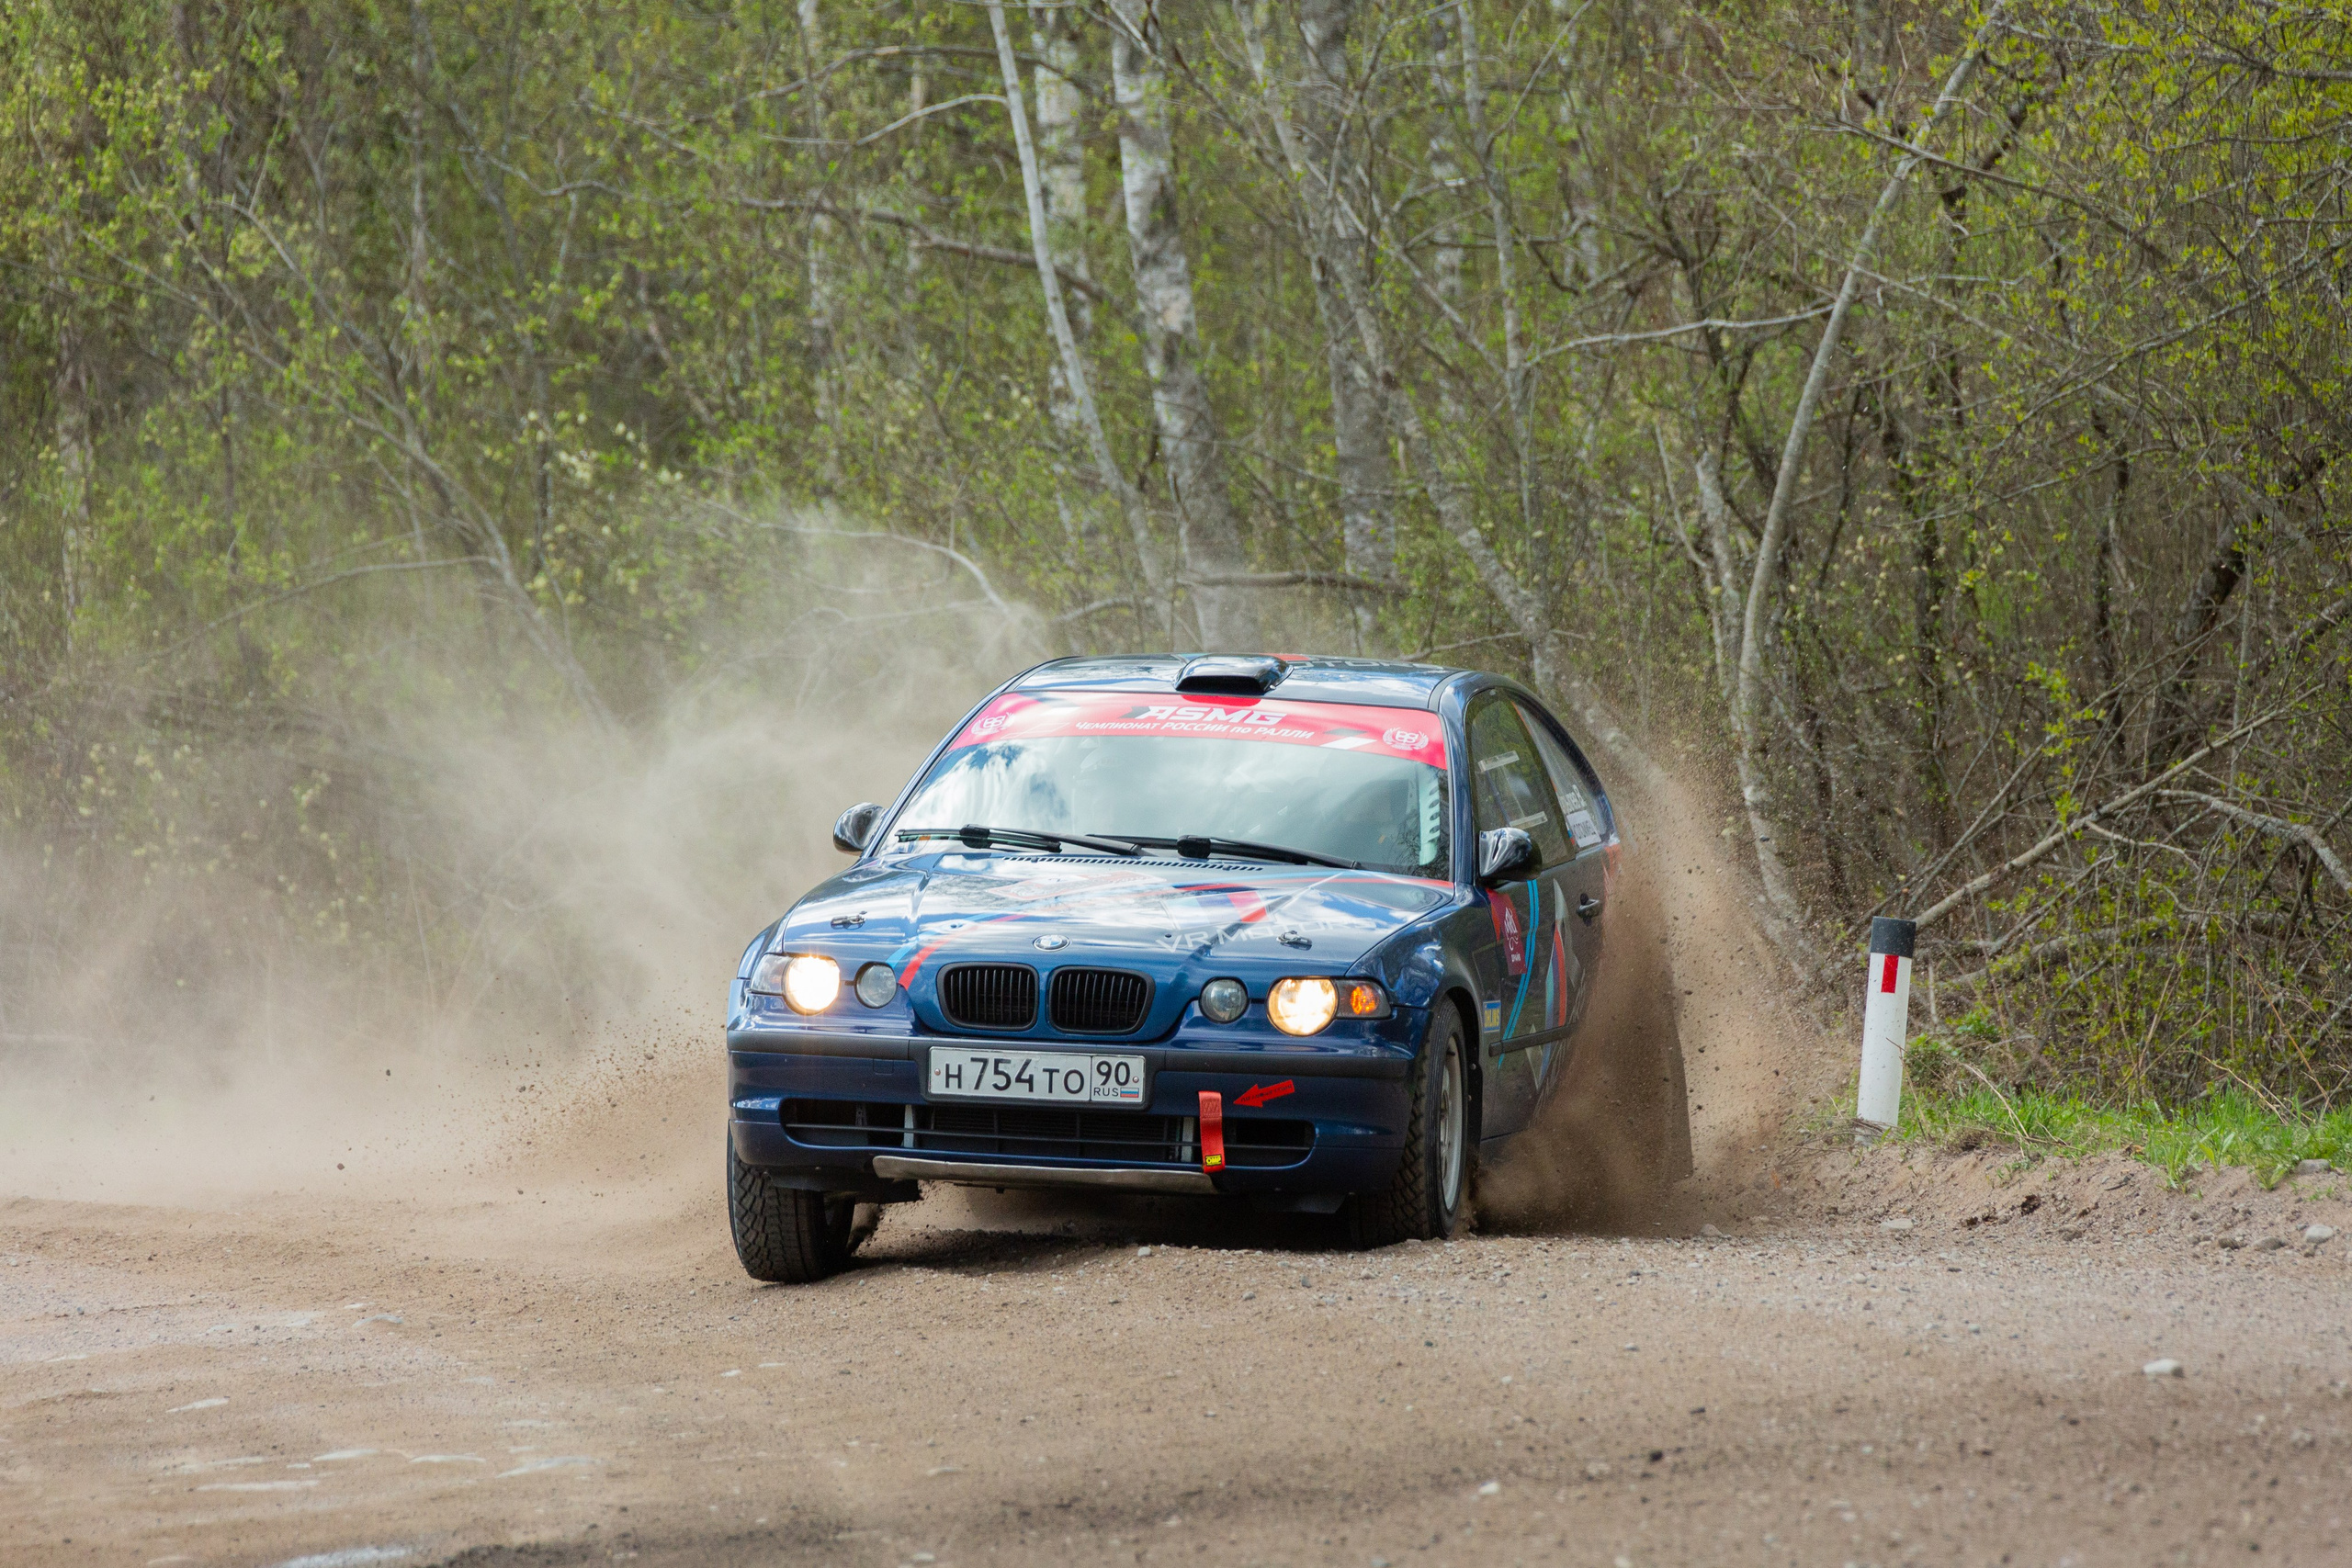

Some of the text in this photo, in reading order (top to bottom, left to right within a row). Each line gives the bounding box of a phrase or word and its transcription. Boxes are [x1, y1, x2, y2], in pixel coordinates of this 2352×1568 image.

[1134, 705, 1287, 726] ASMG
[1075, 721, 1160, 730] ЧЕМПИОНАТ
[1160, 721, 1230, 733] РОССИИ
[1253, 727, 1316, 739] РАЛЛИ
[1155, 931, 1212, 953] VR
[1096, 1060, 1131, 1086] 90
[1093, 1087, 1119, 1098] RUS
